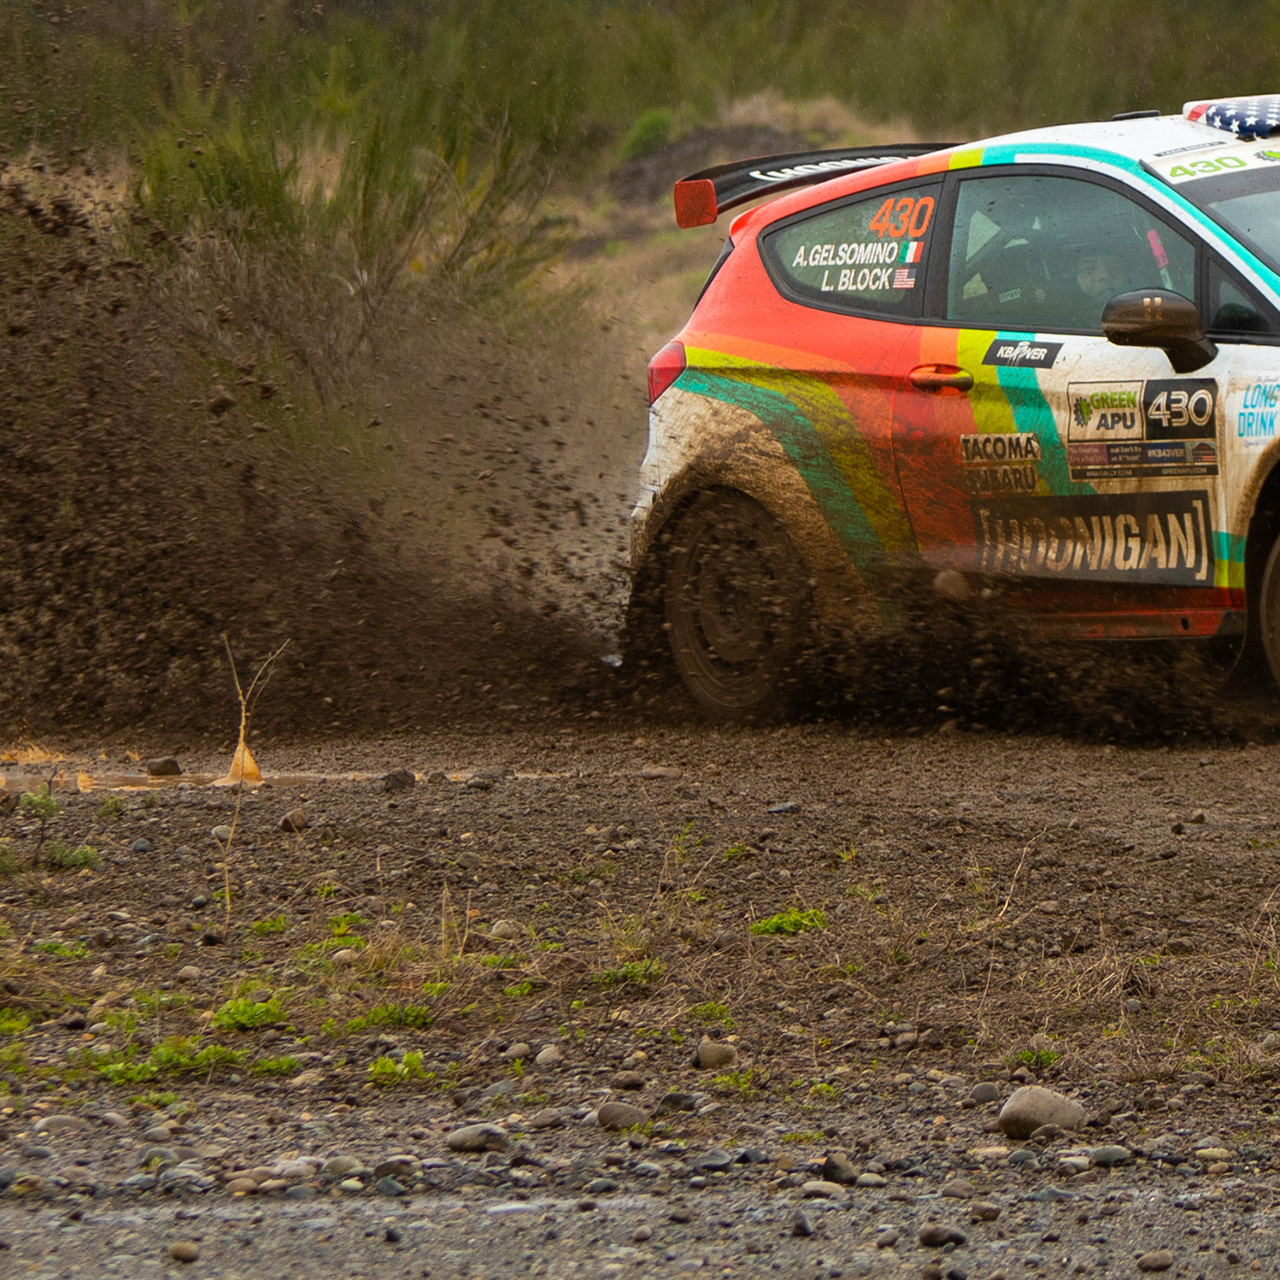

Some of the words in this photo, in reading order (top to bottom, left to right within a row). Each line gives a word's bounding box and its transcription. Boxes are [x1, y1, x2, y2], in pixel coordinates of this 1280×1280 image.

[1169, 156, 1247, 179] 430
[869, 196, 935, 238] 430
[821, 269, 834, 292] L.
[838, 268, 894, 291] BLOCK
[1090, 391, 1138, 410] GREEN
[1147, 389, 1213, 427] 430
[1243, 384, 1280, 409] LONG
[1096, 412, 1136, 431] APU
[1238, 410, 1279, 438] DRINK
[961, 436, 1037, 460] TACOMA
